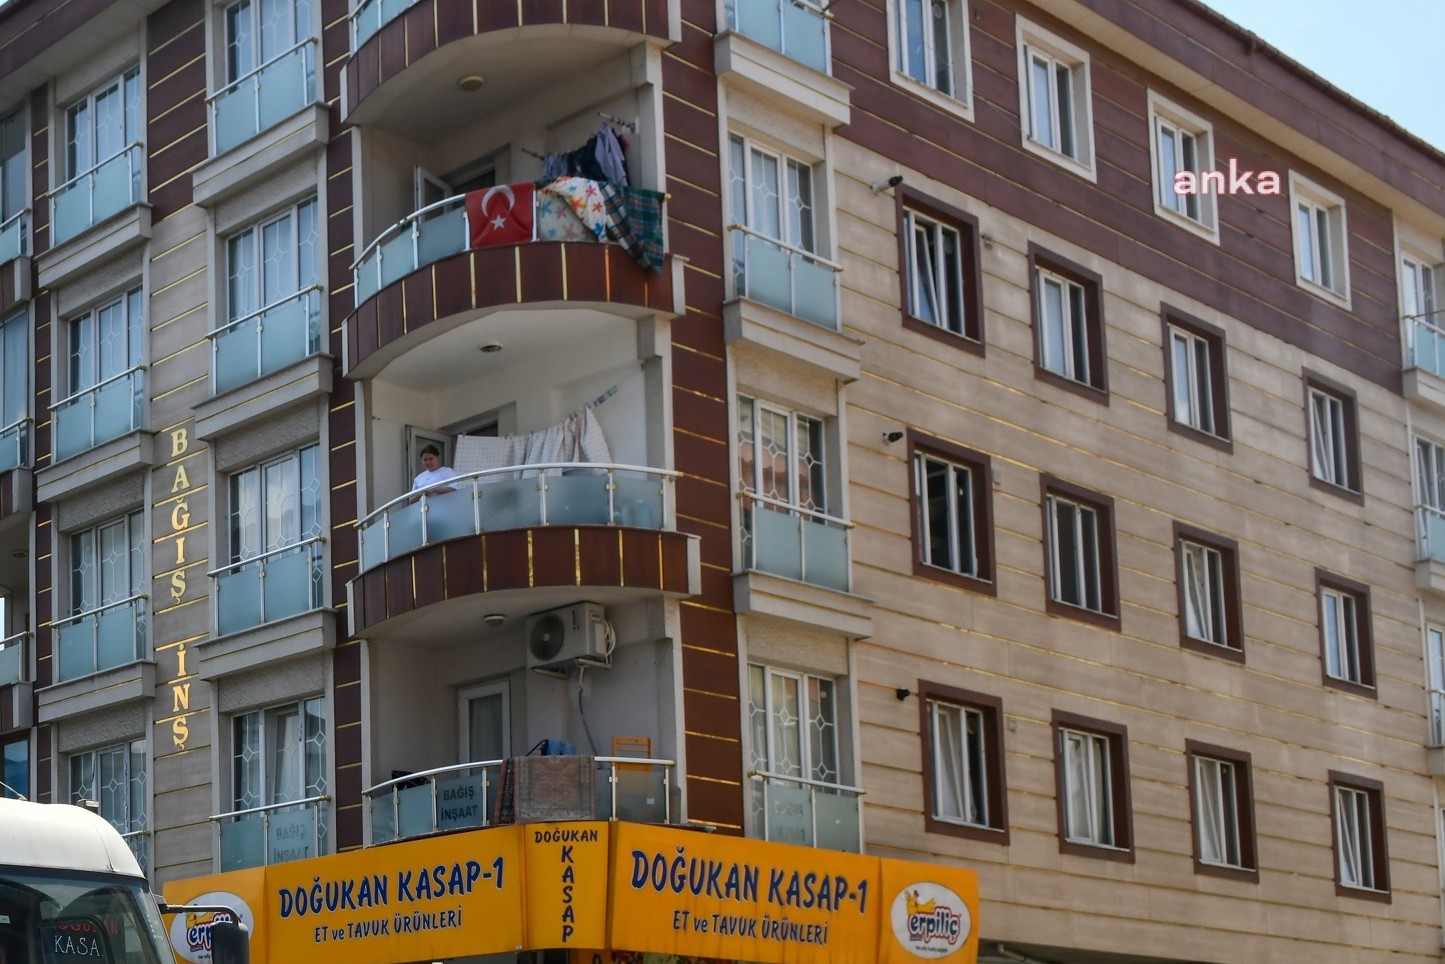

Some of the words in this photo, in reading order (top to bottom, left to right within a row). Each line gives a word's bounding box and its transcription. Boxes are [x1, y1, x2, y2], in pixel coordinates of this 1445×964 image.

[171, 427, 191, 605] BAĞIŞ
[172, 643, 191, 752] İNŞ
[443, 785, 475, 801] BAĞIŞ
[440, 804, 479, 822] İNŞAAT
[534, 827, 599, 844] DOĞUKAN
[278, 875, 389, 919] DOĞUKAN
[397, 855, 506, 904] KASAP-1
[560, 845, 576, 943] KASAP
[630, 846, 761, 904] DOĞUKAN
[767, 867, 869, 915] KASAP-1
[314, 924, 330, 944] ET
[331, 926, 346, 941] ve
[347, 918, 391, 940] TAVUK
[392, 905, 464, 935] ÜRÜNLERİ
[672, 910, 691, 931] ET
[692, 917, 709, 934] ve
[711, 912, 757, 939] TAVUK
[761, 914, 830, 948] ÜRÜNLERİ
[909, 908, 960, 943] erpiliç
[54, 934, 104, 957] KASA
